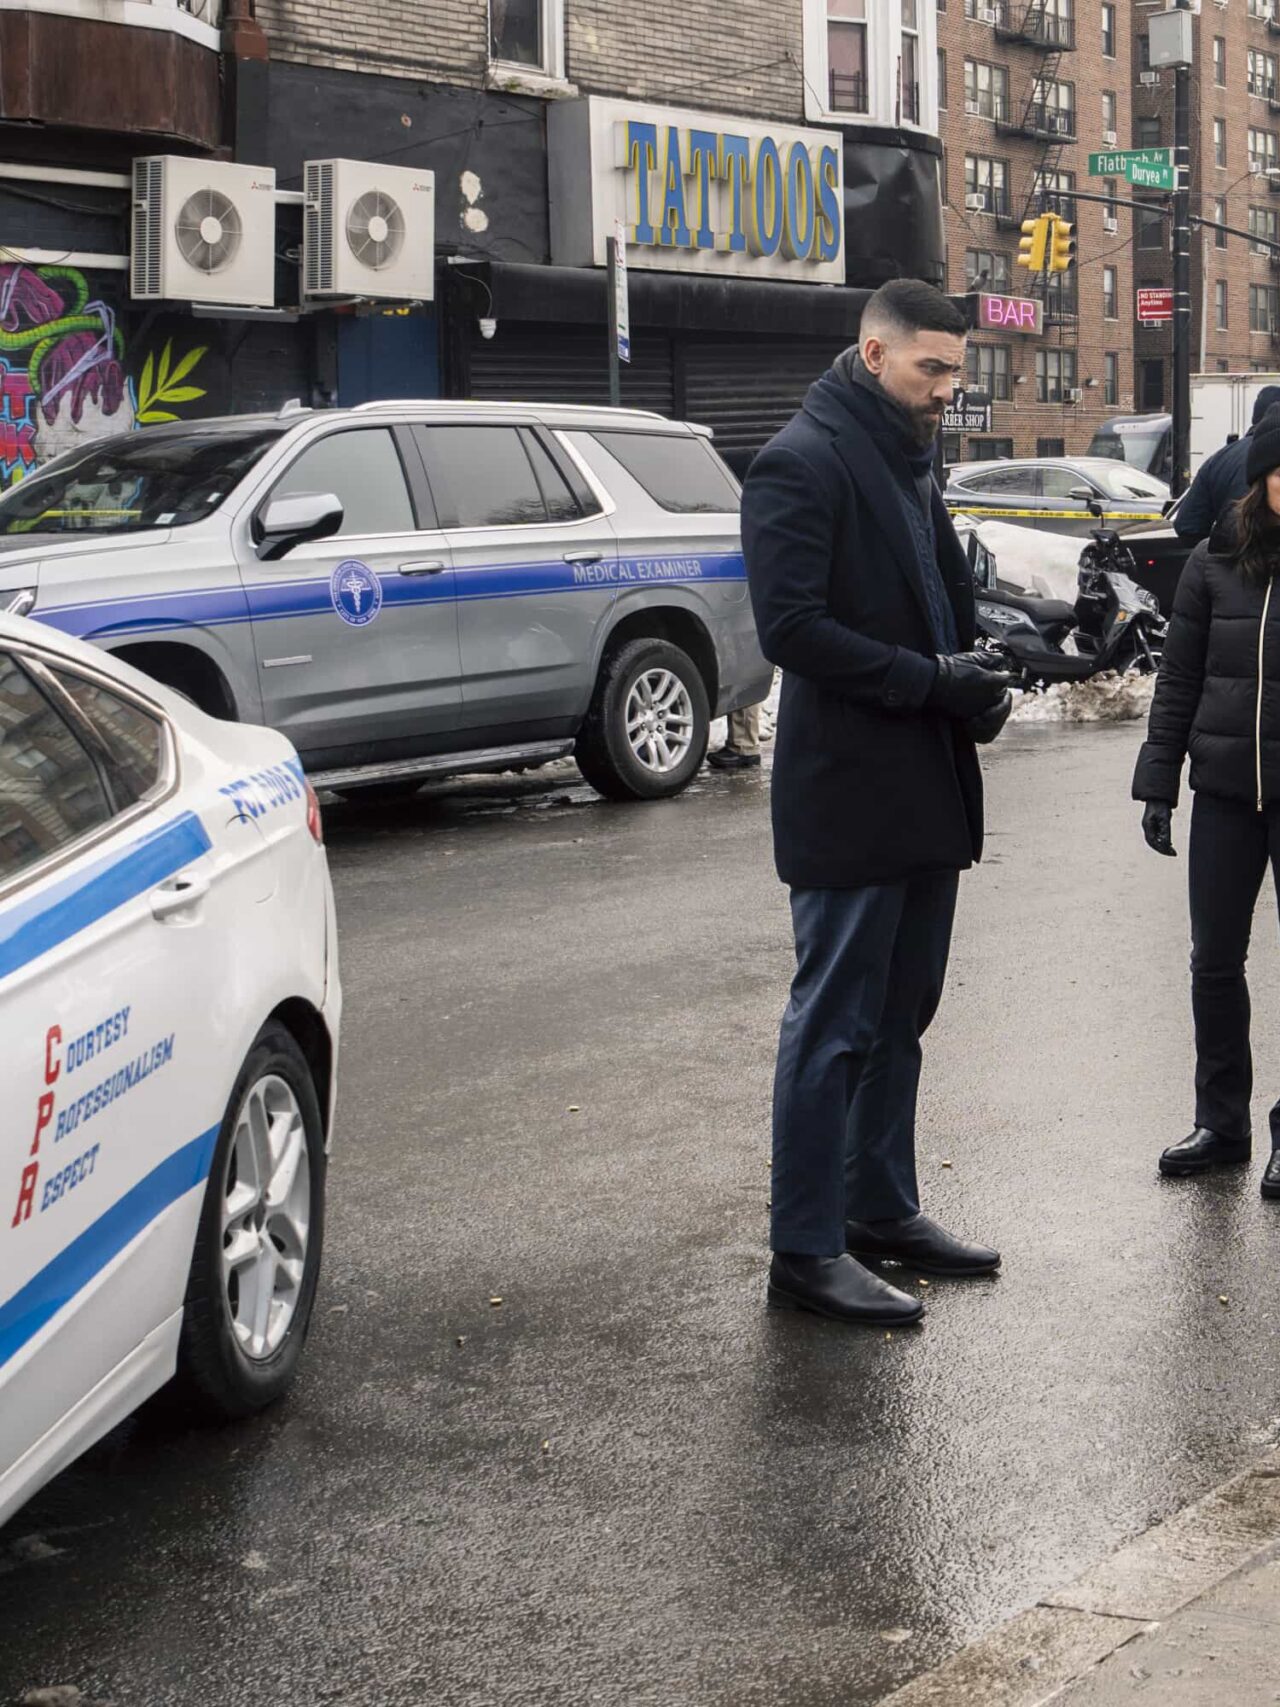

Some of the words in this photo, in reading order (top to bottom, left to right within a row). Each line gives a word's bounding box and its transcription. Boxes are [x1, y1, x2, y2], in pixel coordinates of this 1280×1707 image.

[1132, 163, 1160, 186] Duryea
[622, 120, 840, 263] TATTOOS
[988, 298, 1035, 328] BAR
[965, 414, 985, 428] SHOP
[573, 563, 636, 584] MEDICAL
[636, 559, 703, 579] EXAMINER
